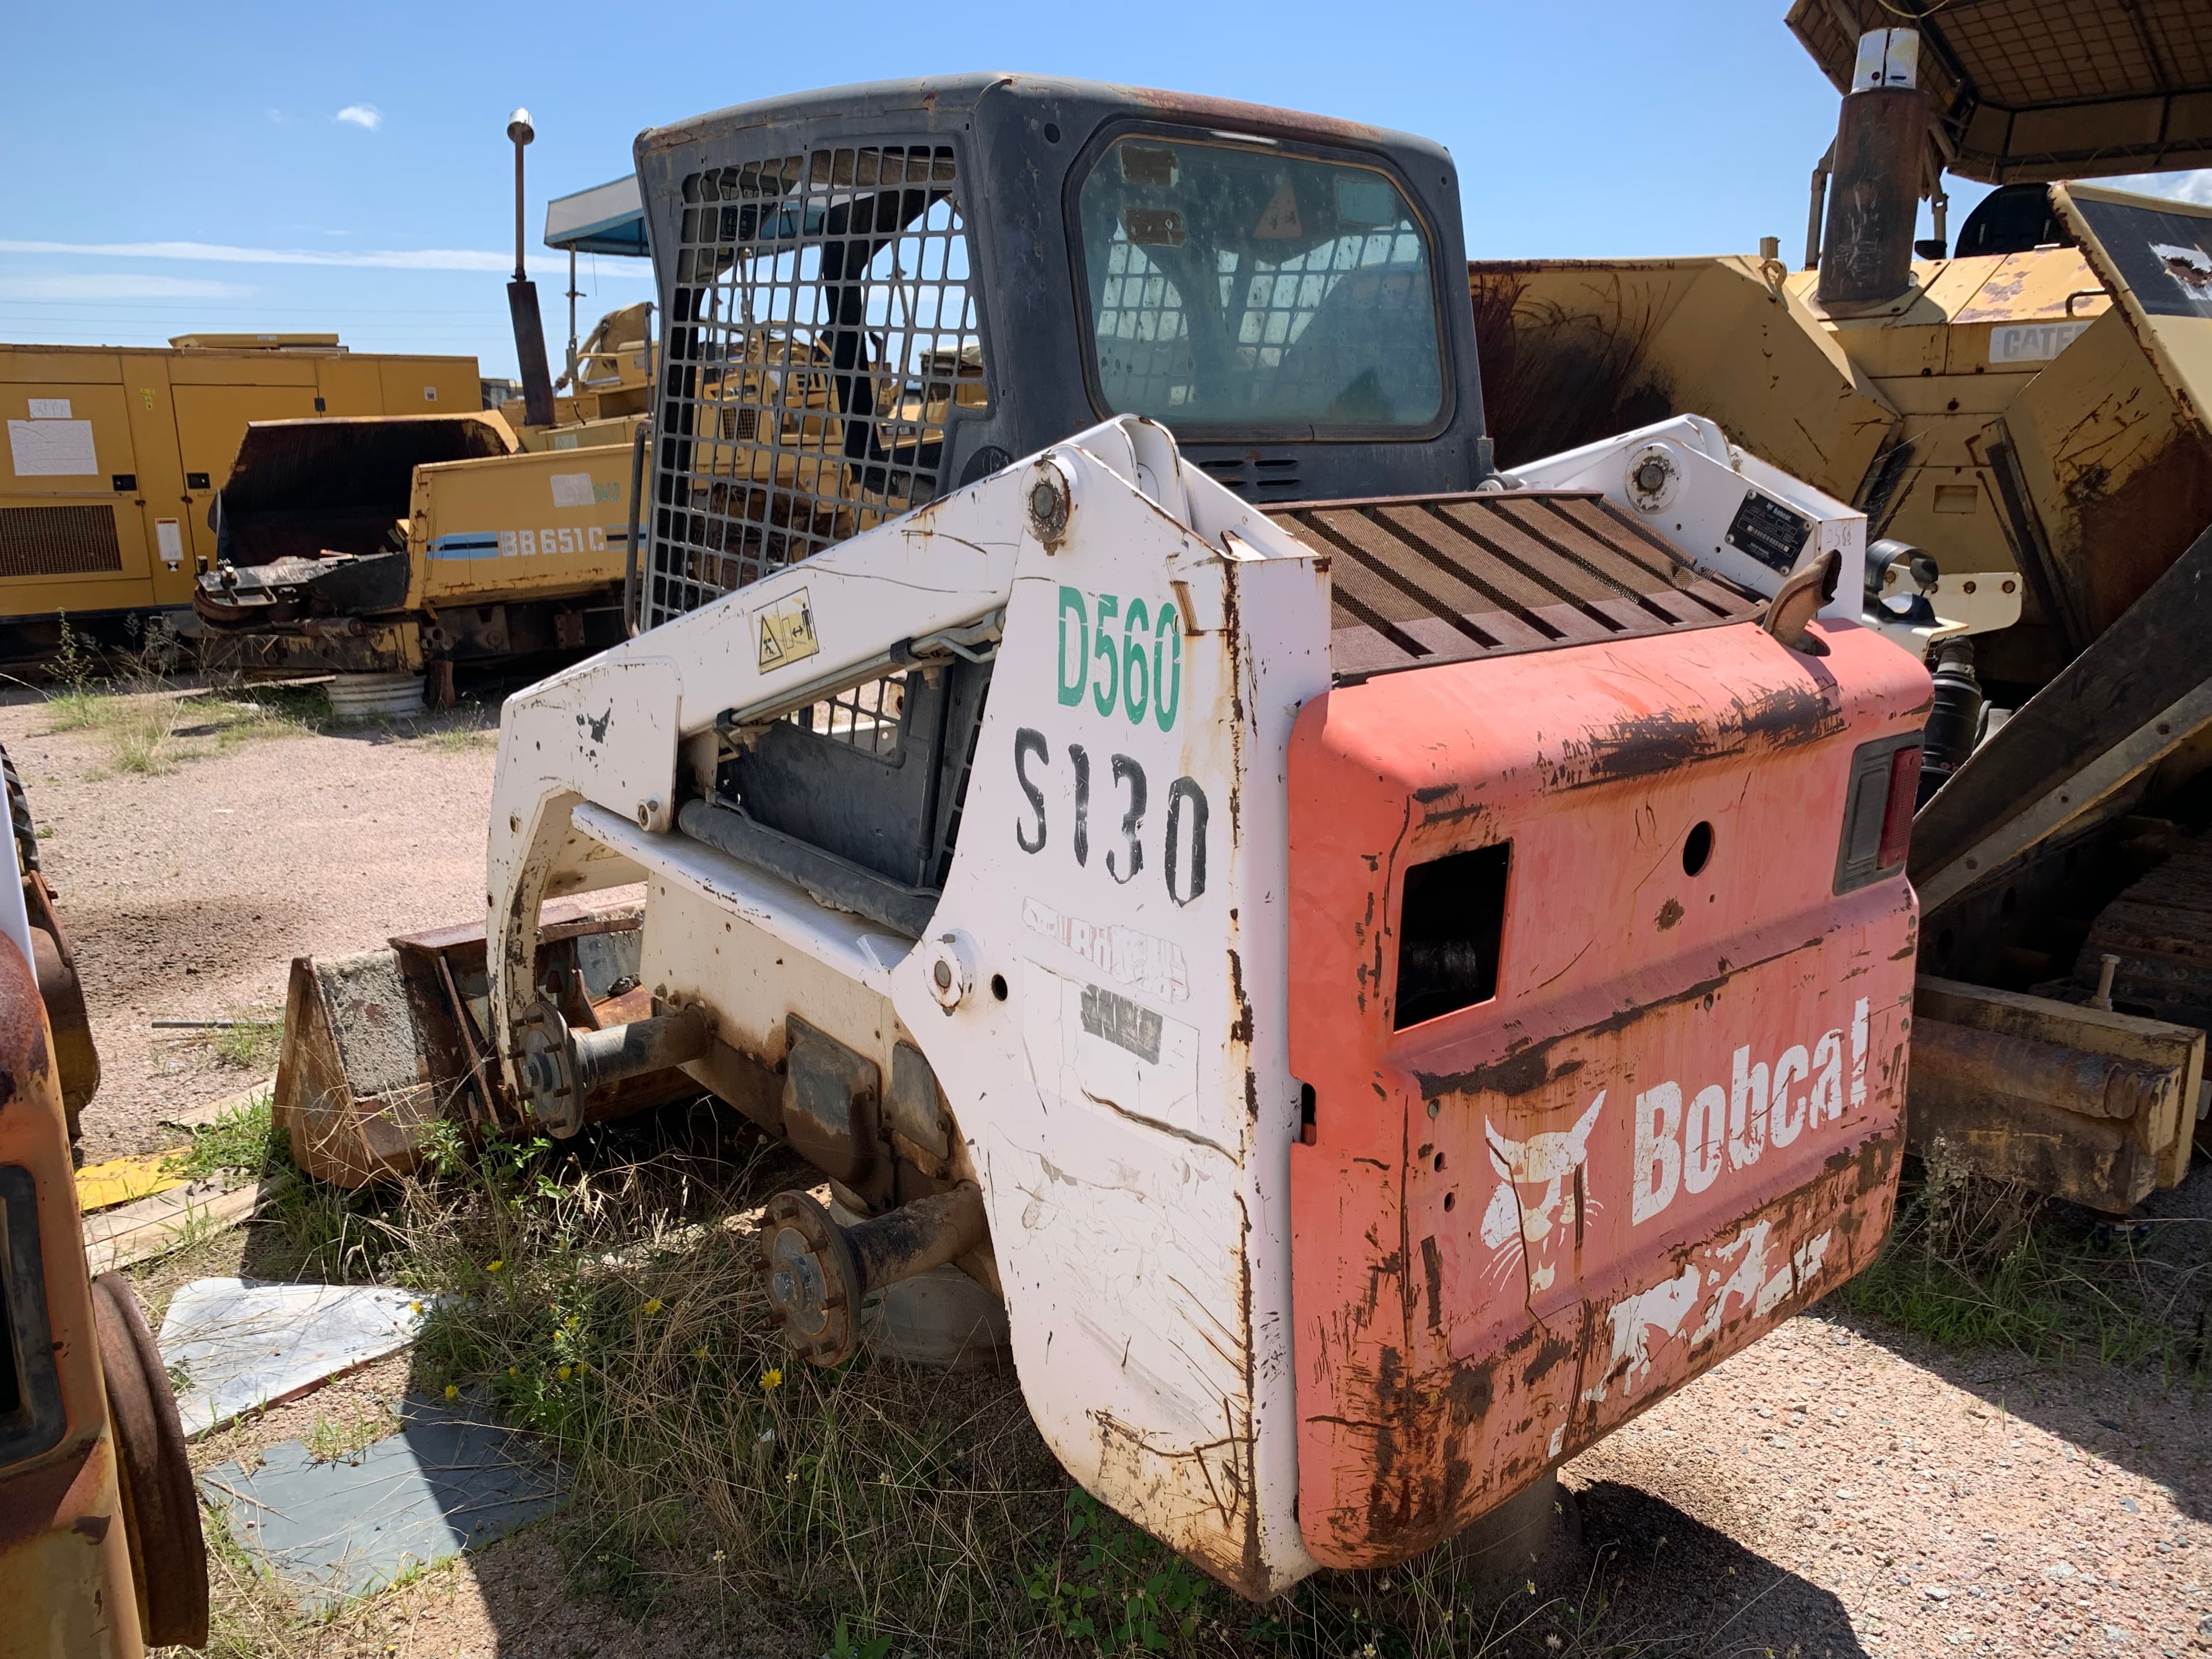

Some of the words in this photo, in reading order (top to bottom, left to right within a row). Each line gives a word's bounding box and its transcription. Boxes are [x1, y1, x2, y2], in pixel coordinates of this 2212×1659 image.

[2003, 325, 2089, 359] CATE
[1058, 585, 1181, 732] D560
[1014, 726, 1209, 908] S130
[1632, 995, 1870, 1227] Bobcat
